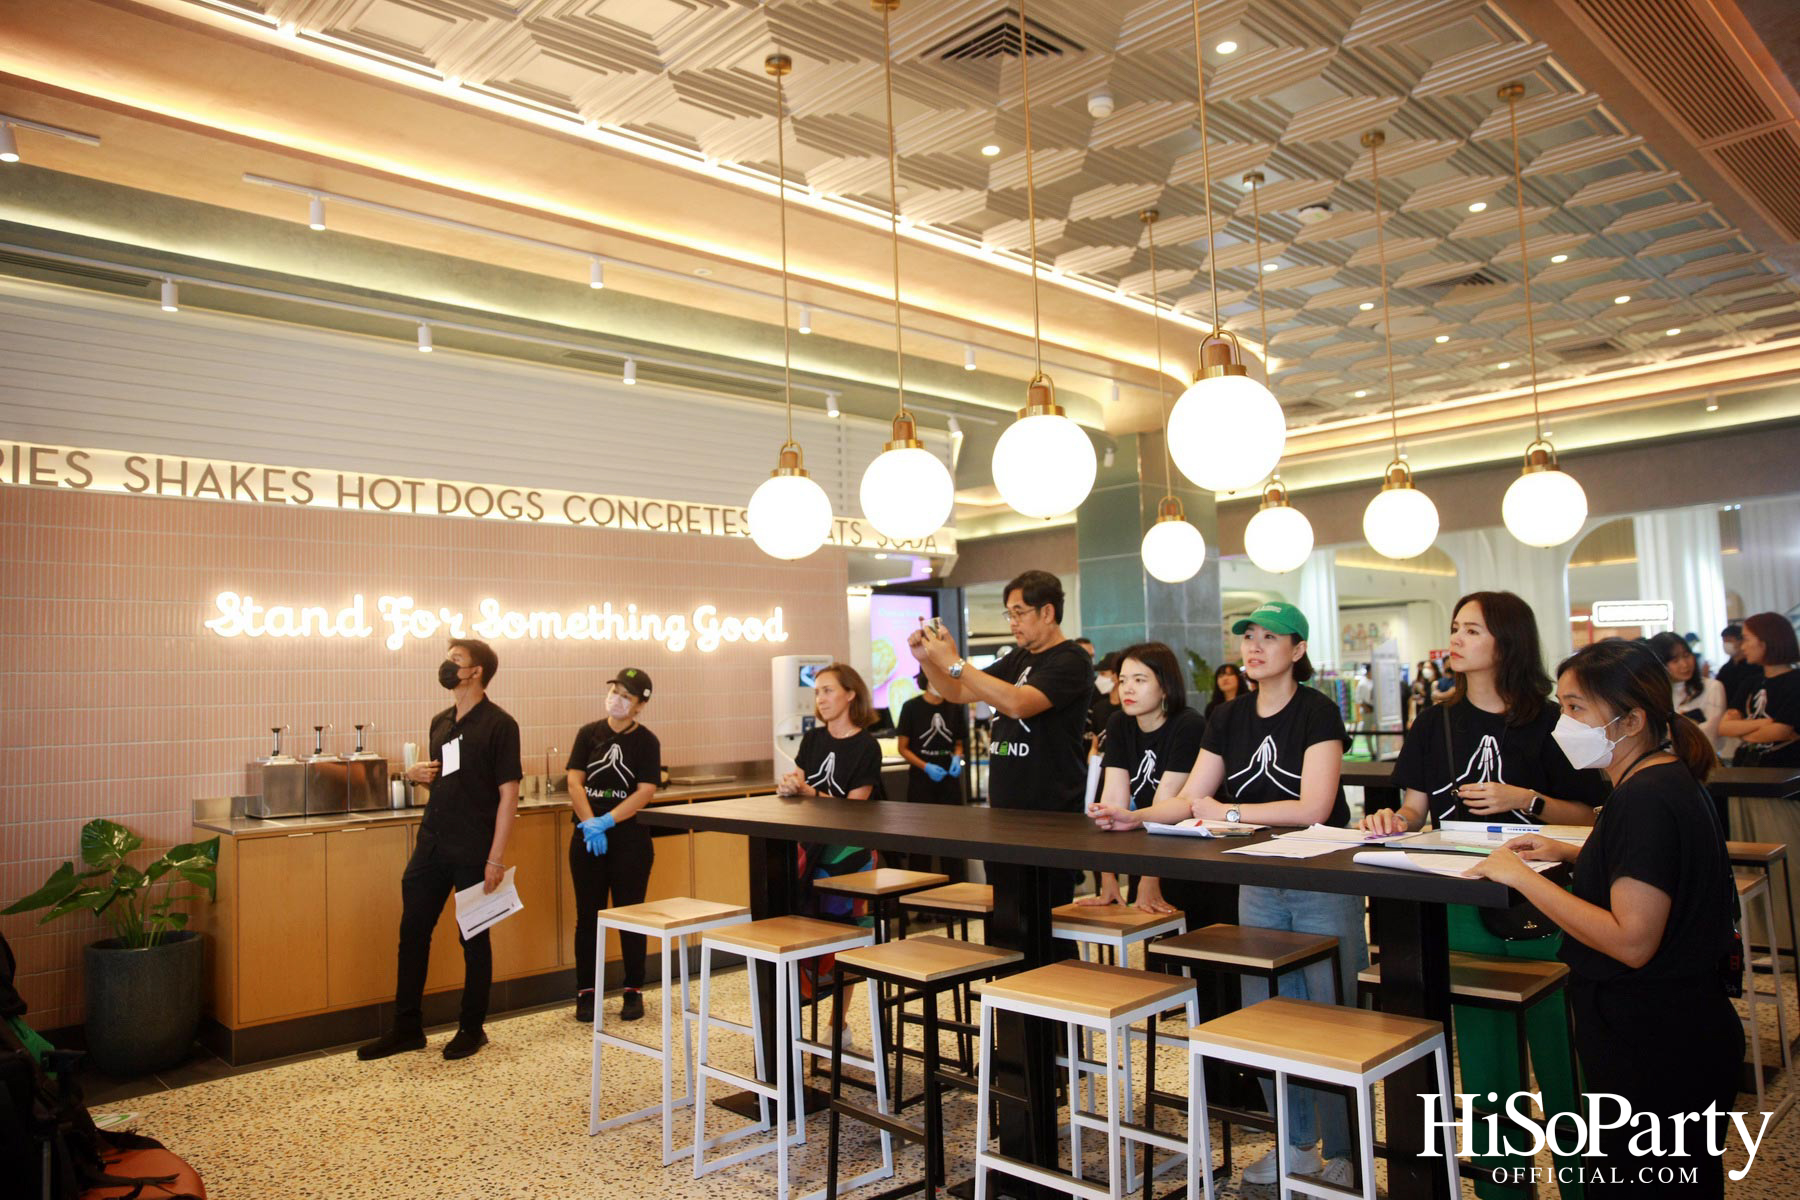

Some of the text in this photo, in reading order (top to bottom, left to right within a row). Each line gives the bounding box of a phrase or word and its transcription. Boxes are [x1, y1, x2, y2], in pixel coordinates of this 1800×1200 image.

[0, 445, 93, 489] IES
[122, 456, 314, 505] SHAKES
[337, 474, 425, 513] HOT
[437, 483, 544, 521] DOGS
[204, 591, 788, 652] Stand For Something Good
